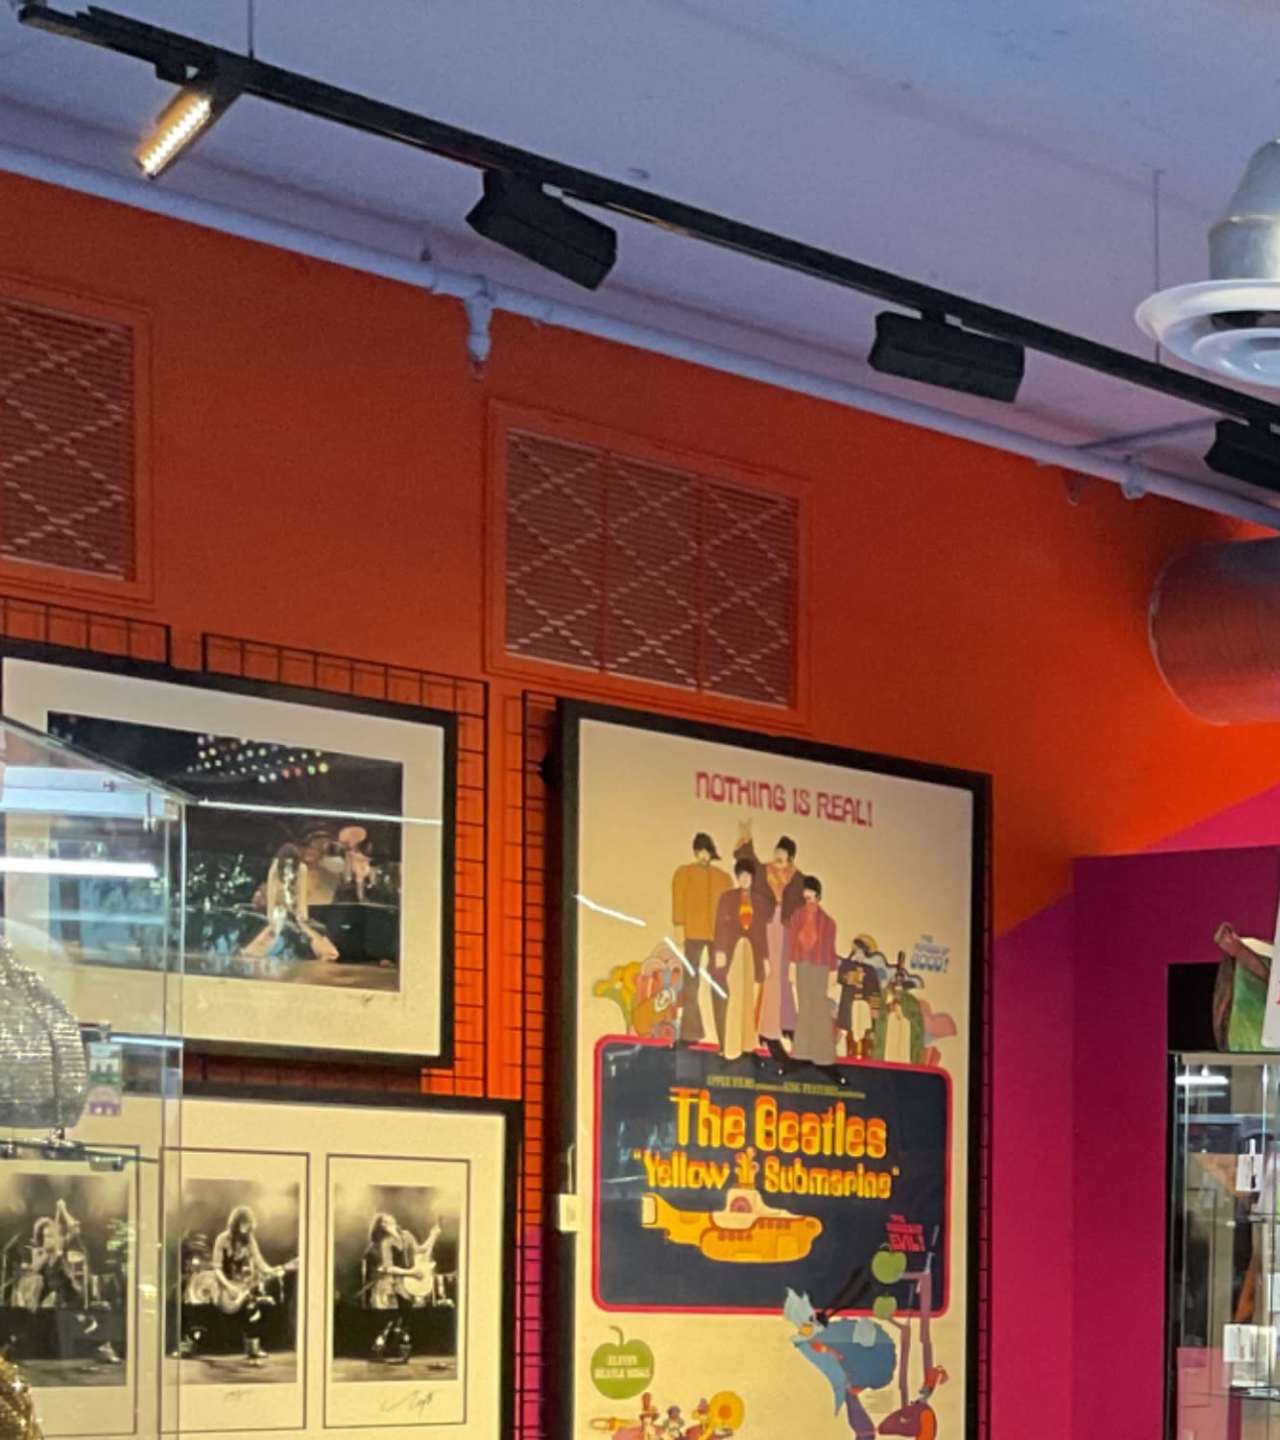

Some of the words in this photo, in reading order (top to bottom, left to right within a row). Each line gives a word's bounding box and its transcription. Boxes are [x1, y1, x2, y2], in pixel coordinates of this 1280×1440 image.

[696, 771, 786, 812] NOTHING
[793, 788, 811, 816] IS
[816, 792, 873, 827] REAL!
[669, 1087, 746, 1149] The
[755, 1095, 887, 1158] Beatles
